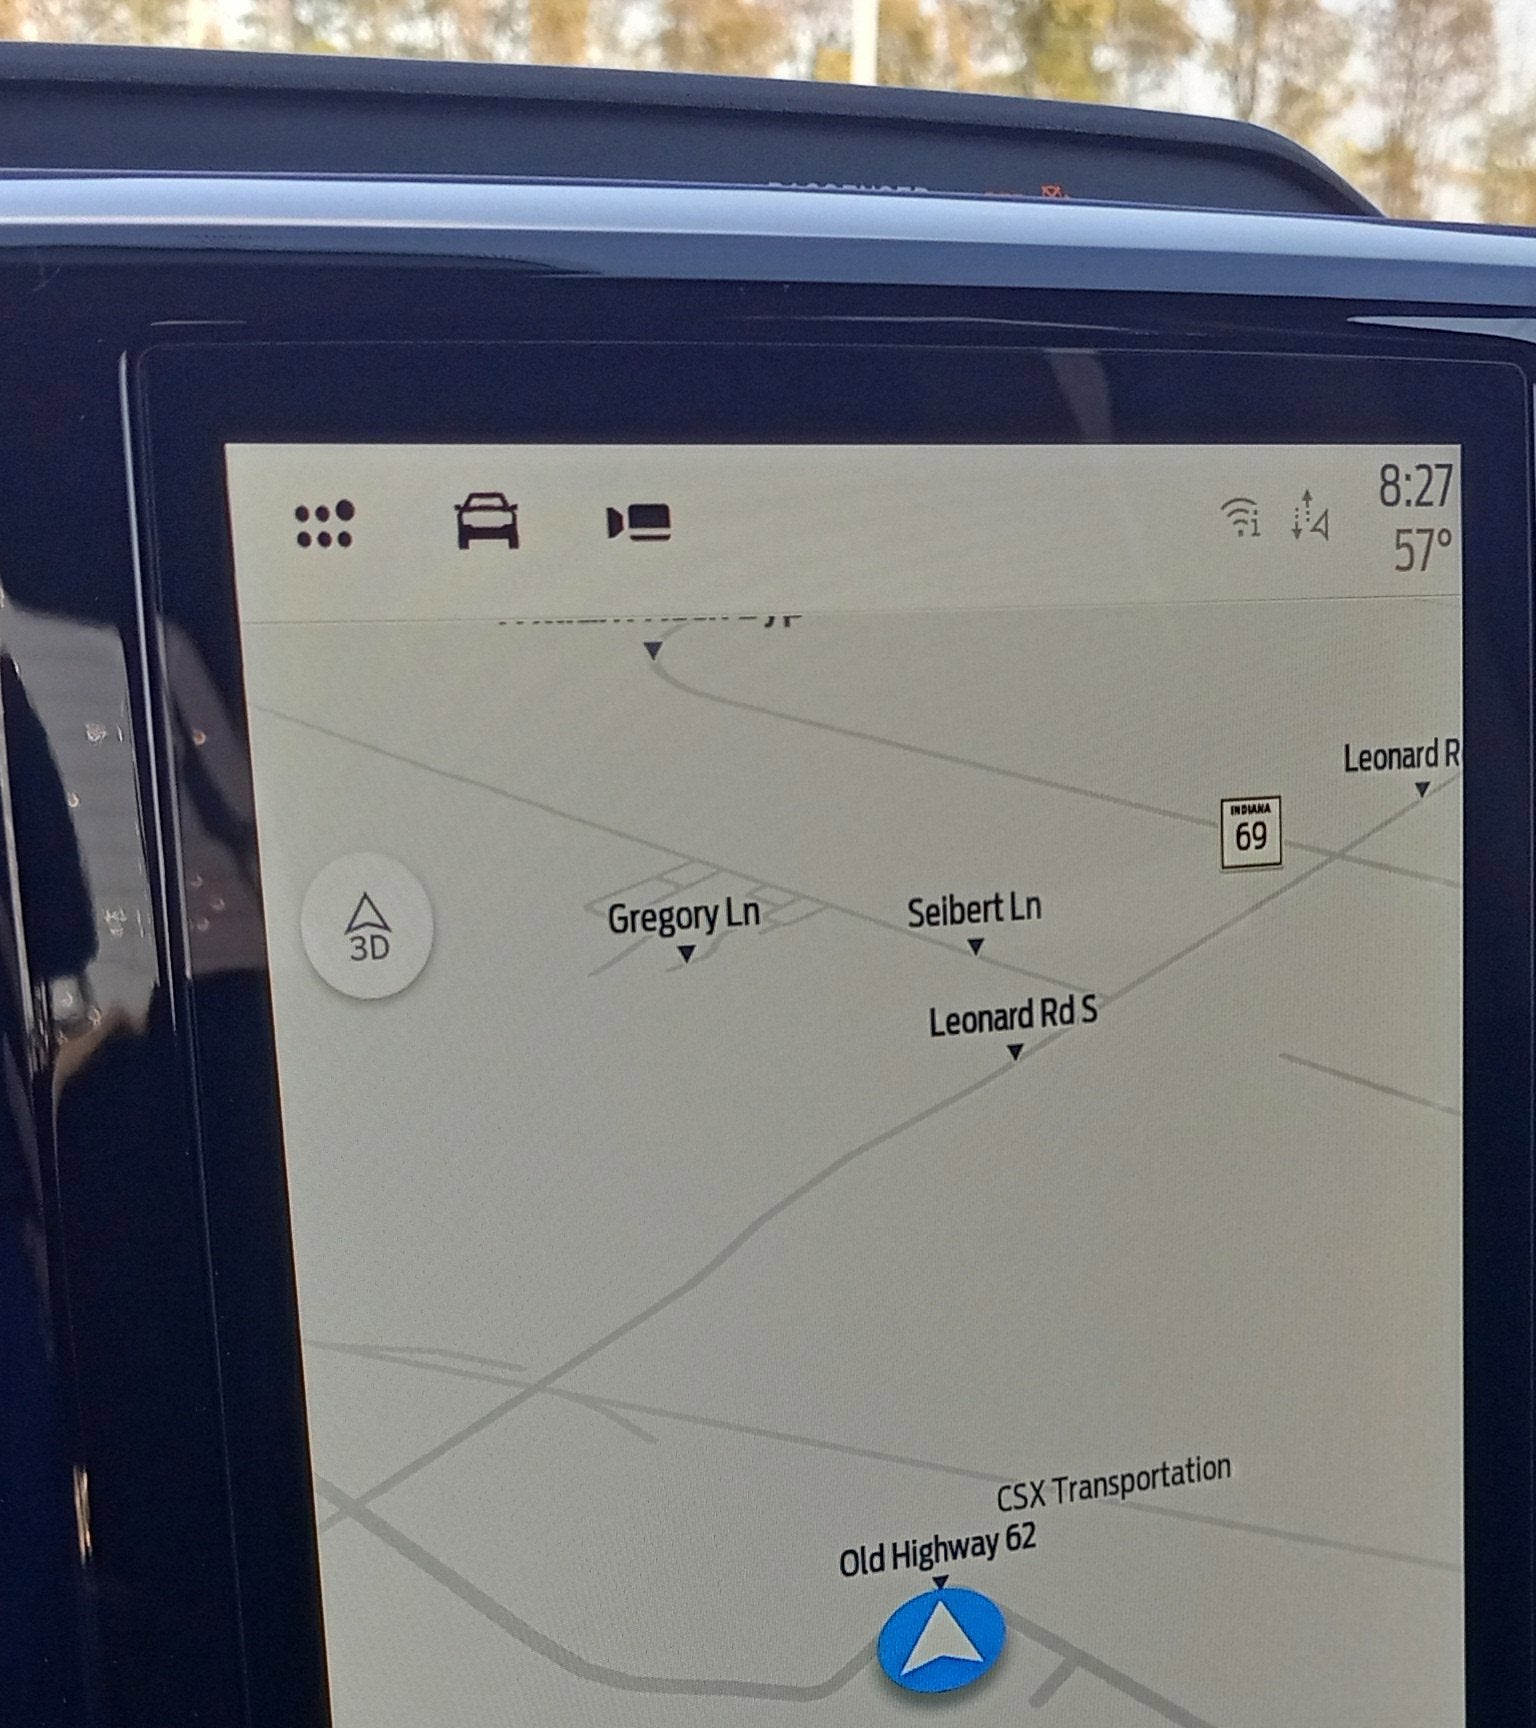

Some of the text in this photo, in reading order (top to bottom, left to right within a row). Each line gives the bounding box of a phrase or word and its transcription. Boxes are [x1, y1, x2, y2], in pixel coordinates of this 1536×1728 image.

[1379, 462, 1454, 508] 8:27
[1394, 527, 1452, 572] 57°
[1344, 737, 1438, 773] Leonard
[1230, 802, 1272, 815] INDIANA
[1235, 820, 1268, 851] 69
[608, 897, 761, 937] Gregory Ln
[907, 891, 1042, 928] Seibert Ln
[349, 935, 390, 961] 3D
[929, 994, 1099, 1037] Leonard Rd S
[997, 1454, 1232, 1512] CSX Transportation
[840, 1520, 1037, 1577] Old Highway 62
